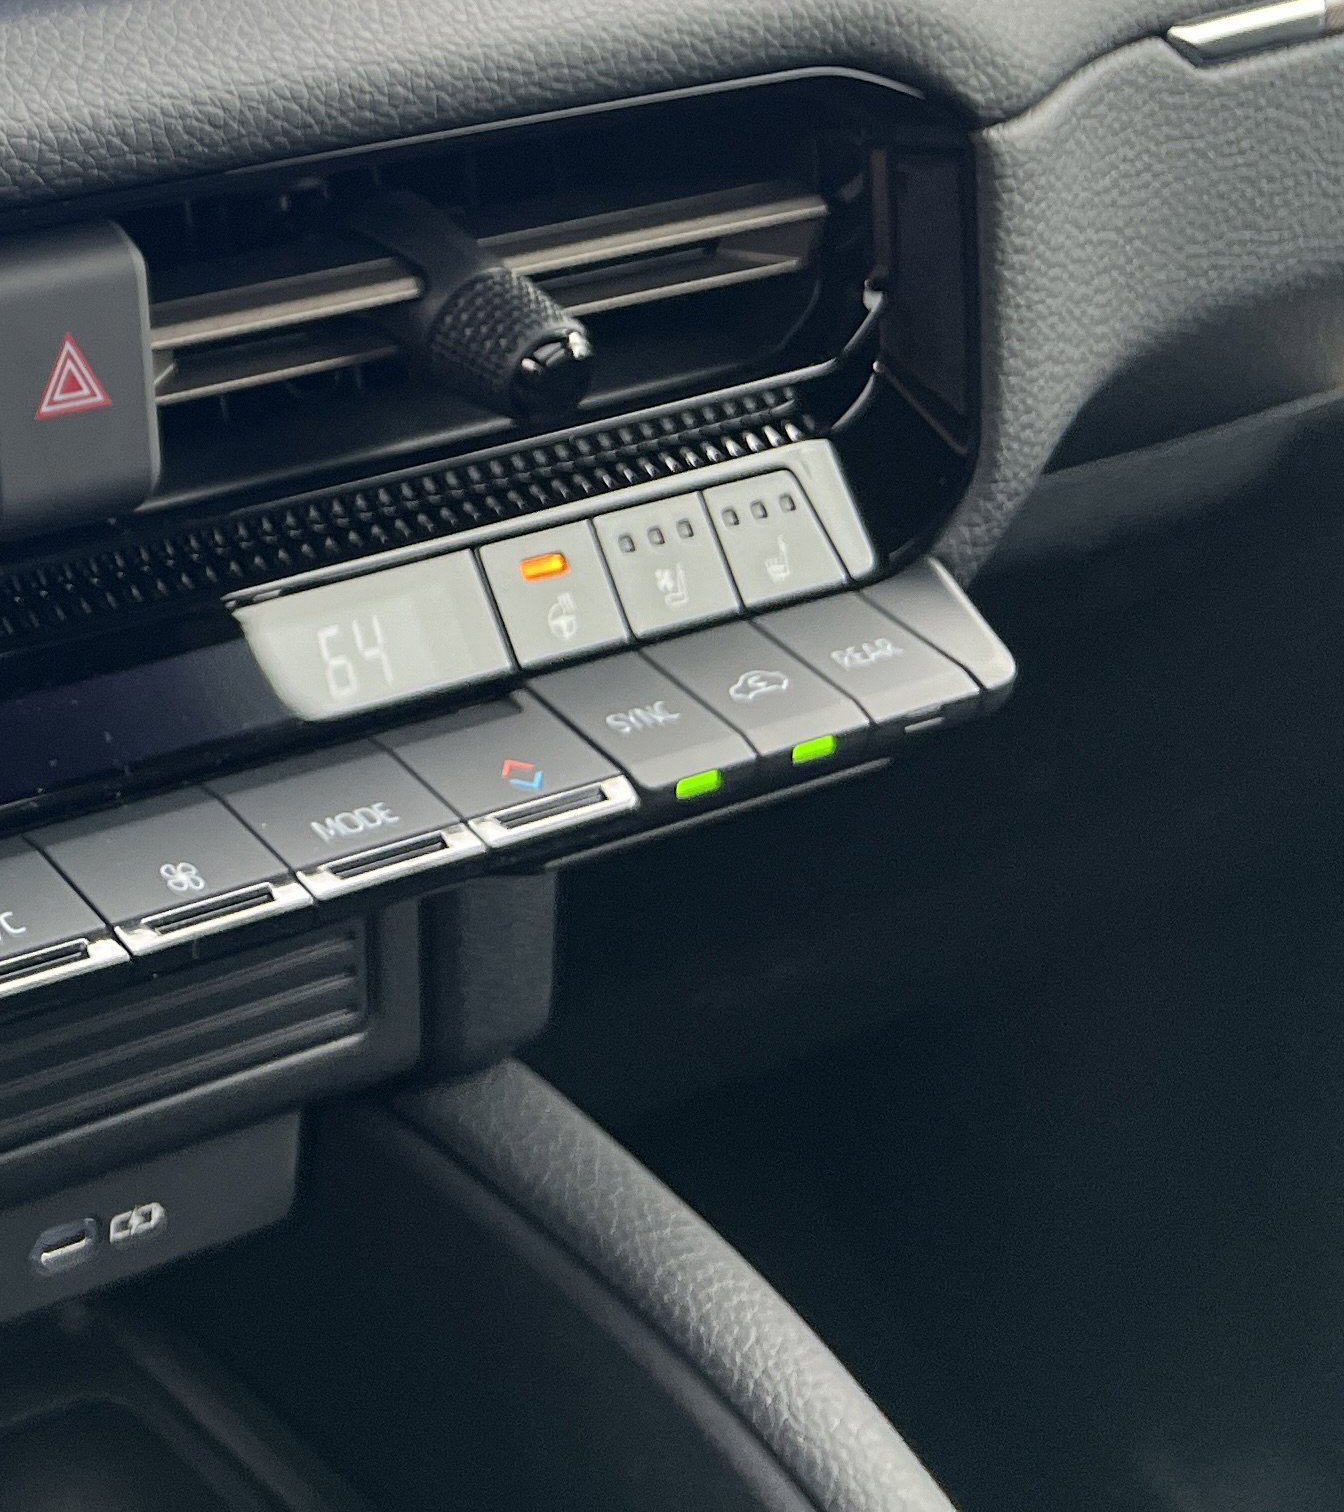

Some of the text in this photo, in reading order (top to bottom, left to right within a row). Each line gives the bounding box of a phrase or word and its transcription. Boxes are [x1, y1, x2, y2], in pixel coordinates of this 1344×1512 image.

[316, 613, 394, 698] 64
[605, 700, 680, 734] SYNC
[311, 802, 400, 841] MODE
